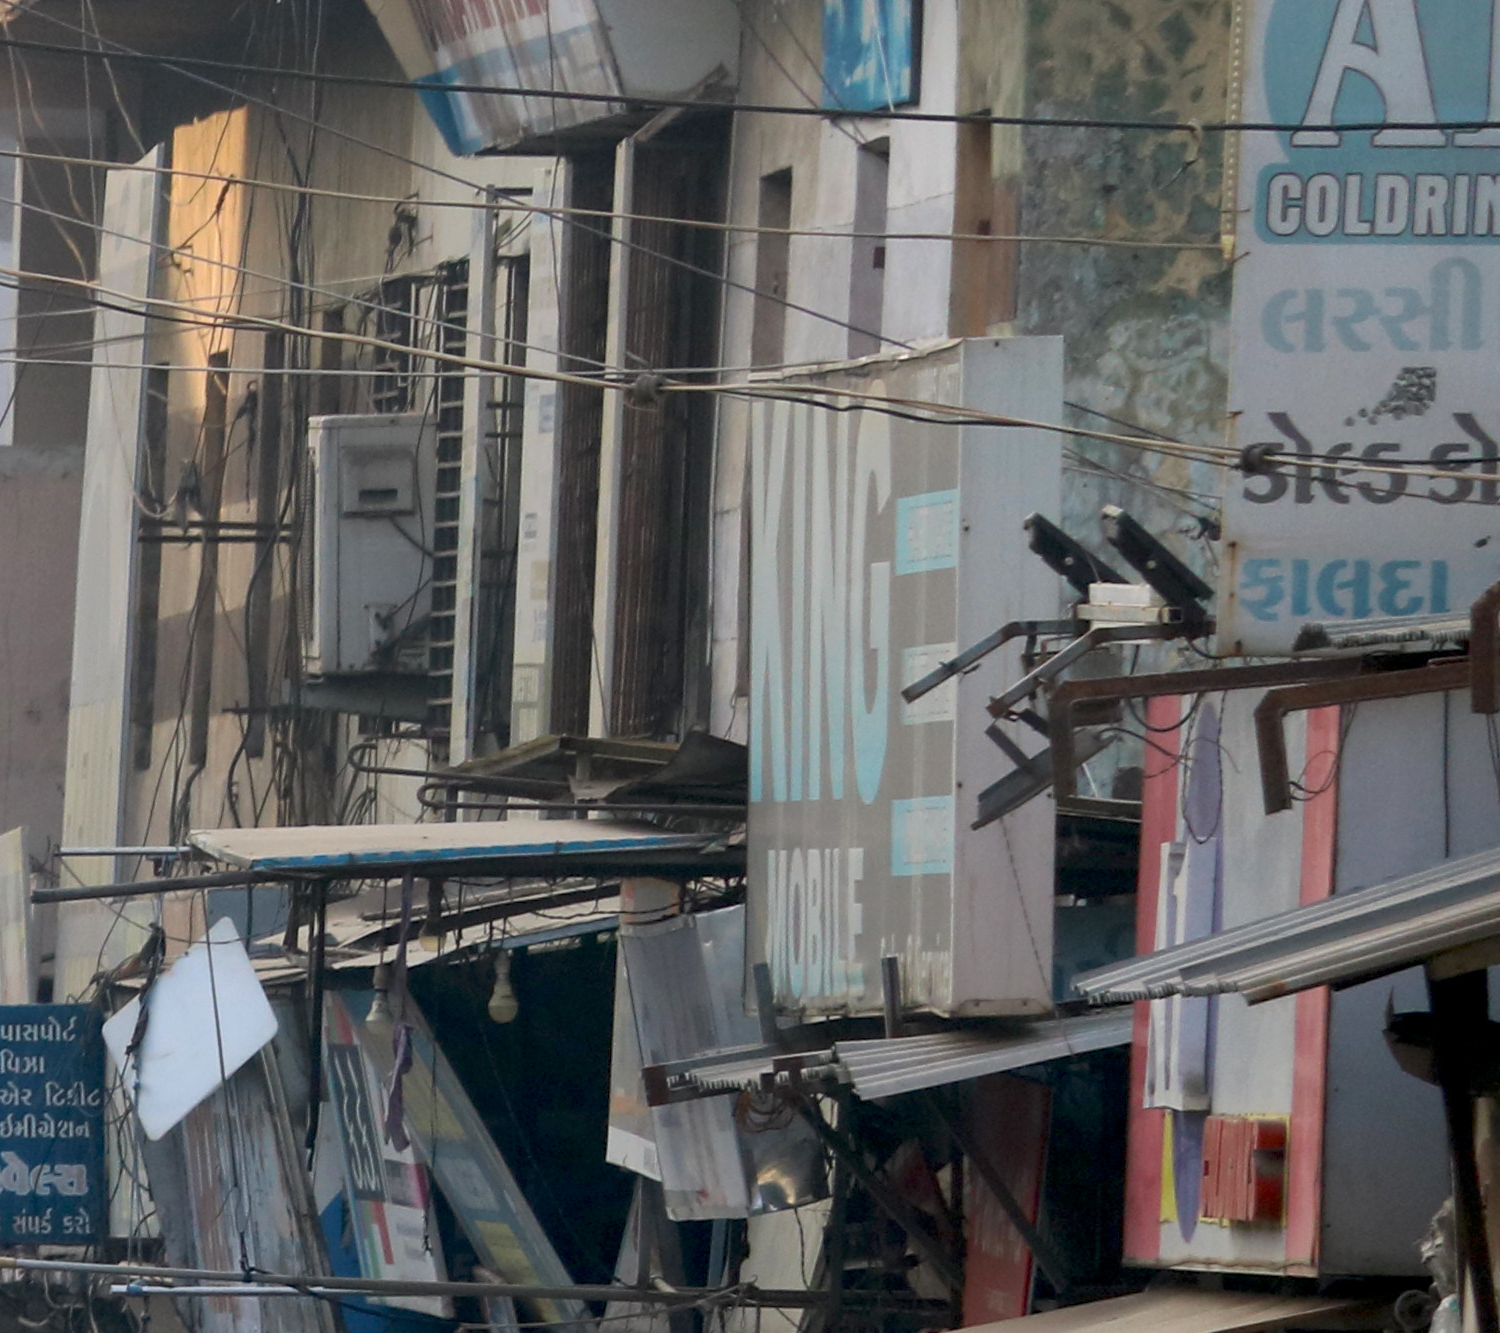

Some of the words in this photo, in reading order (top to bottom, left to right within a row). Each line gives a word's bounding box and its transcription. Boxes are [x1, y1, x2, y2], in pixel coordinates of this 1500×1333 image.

[750, 376, 892, 806] KING
[765, 846, 865, 1000] MOBILE
[0, 1016, 78, 1043] પાસપોર્ટ
